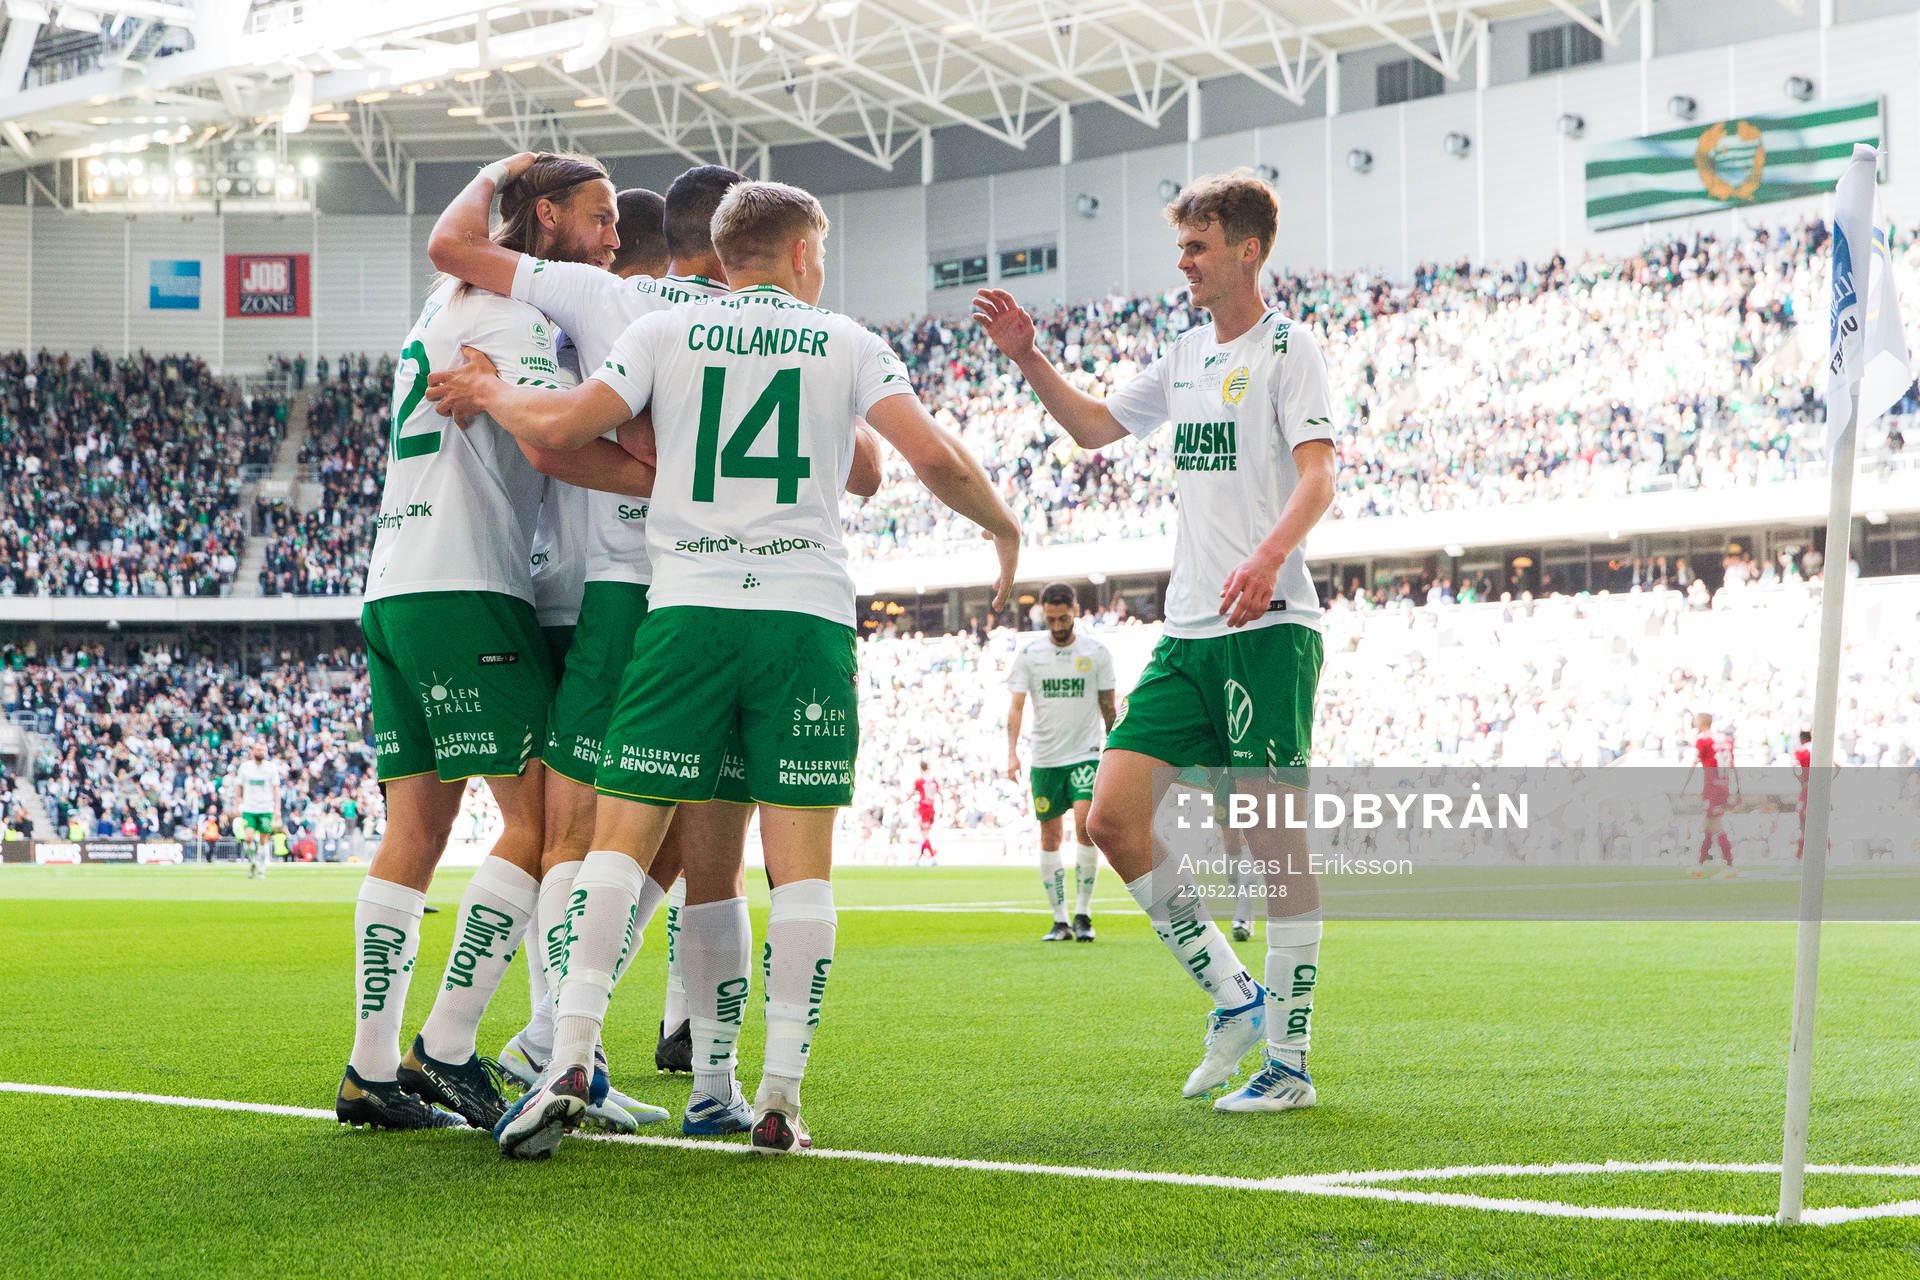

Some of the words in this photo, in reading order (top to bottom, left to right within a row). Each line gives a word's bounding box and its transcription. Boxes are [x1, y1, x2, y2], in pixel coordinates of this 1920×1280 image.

[245, 262, 286, 290] JOB
[240, 296, 295, 312] ZONE
[688, 324, 829, 357] COLLANDER
[520, 356, 558, 371] UNIBET
[692, 366, 811, 504] 14
[1174, 422, 1237, 454] HUSKI
[1042, 678, 1085, 691] HUSKI
[425, 701, 482, 717] STRÅLE
[434, 731, 495, 746] LLSERVICE
[793, 722, 845, 737] STRÅLE
[622, 744, 700, 764] PALLSERVICE
[619, 756, 678, 778] RENOVA
[680, 766, 700, 779] AB
[779, 759, 850, 770] PALLSERVICE
[779, 771, 837, 786] RENOVA
[839, 773, 851, 785] AB
[450, 904, 514, 988] Clinton
[361, 923, 406, 1012] Clinton
[421, 1063, 461, 1107] ULTRA
